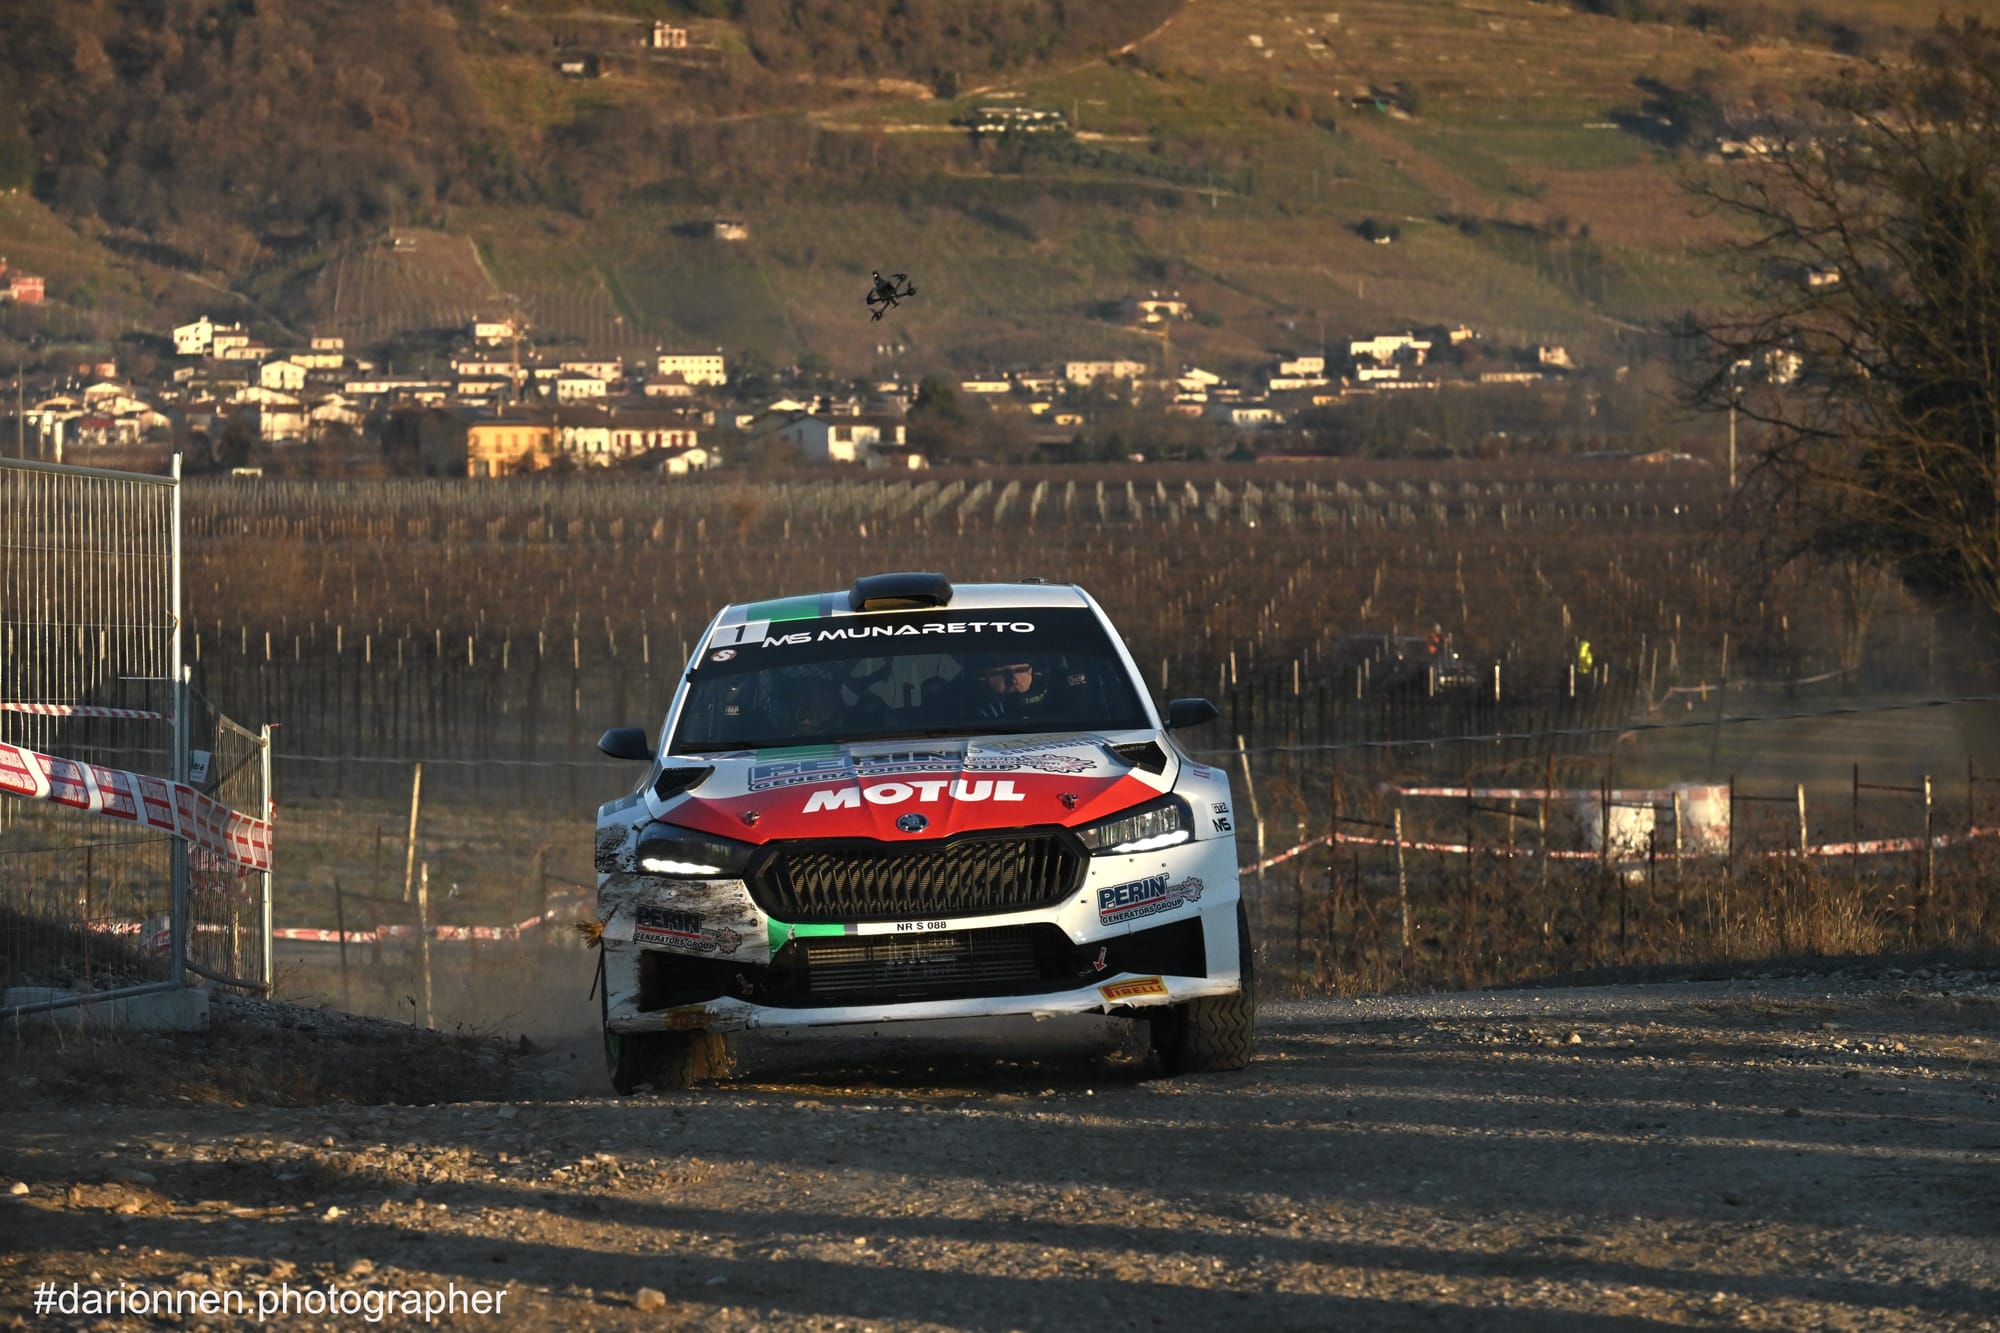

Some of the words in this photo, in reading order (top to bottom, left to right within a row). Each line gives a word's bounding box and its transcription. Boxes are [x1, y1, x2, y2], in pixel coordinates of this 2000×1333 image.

[734, 624, 746, 643] 1
[762, 632, 812, 648] MS
[817, 622, 1035, 641] MUNARETTO
[802, 779, 1026, 813] MOTUL
[1100, 876, 1166, 909] PERIN
[638, 905, 701, 934] PERIN
[1102, 904, 1156, 924] GENERATORS
[1156, 898, 1182, 911] GROUP
[897, 923, 913, 931] NR
[916, 922, 924, 930] S
[927, 921, 947, 930] 088
[635, 932, 684, 946] GENERATORS
[686, 940, 715, 950] GROUP
[1103, 979, 1164, 998] PIRELLI
